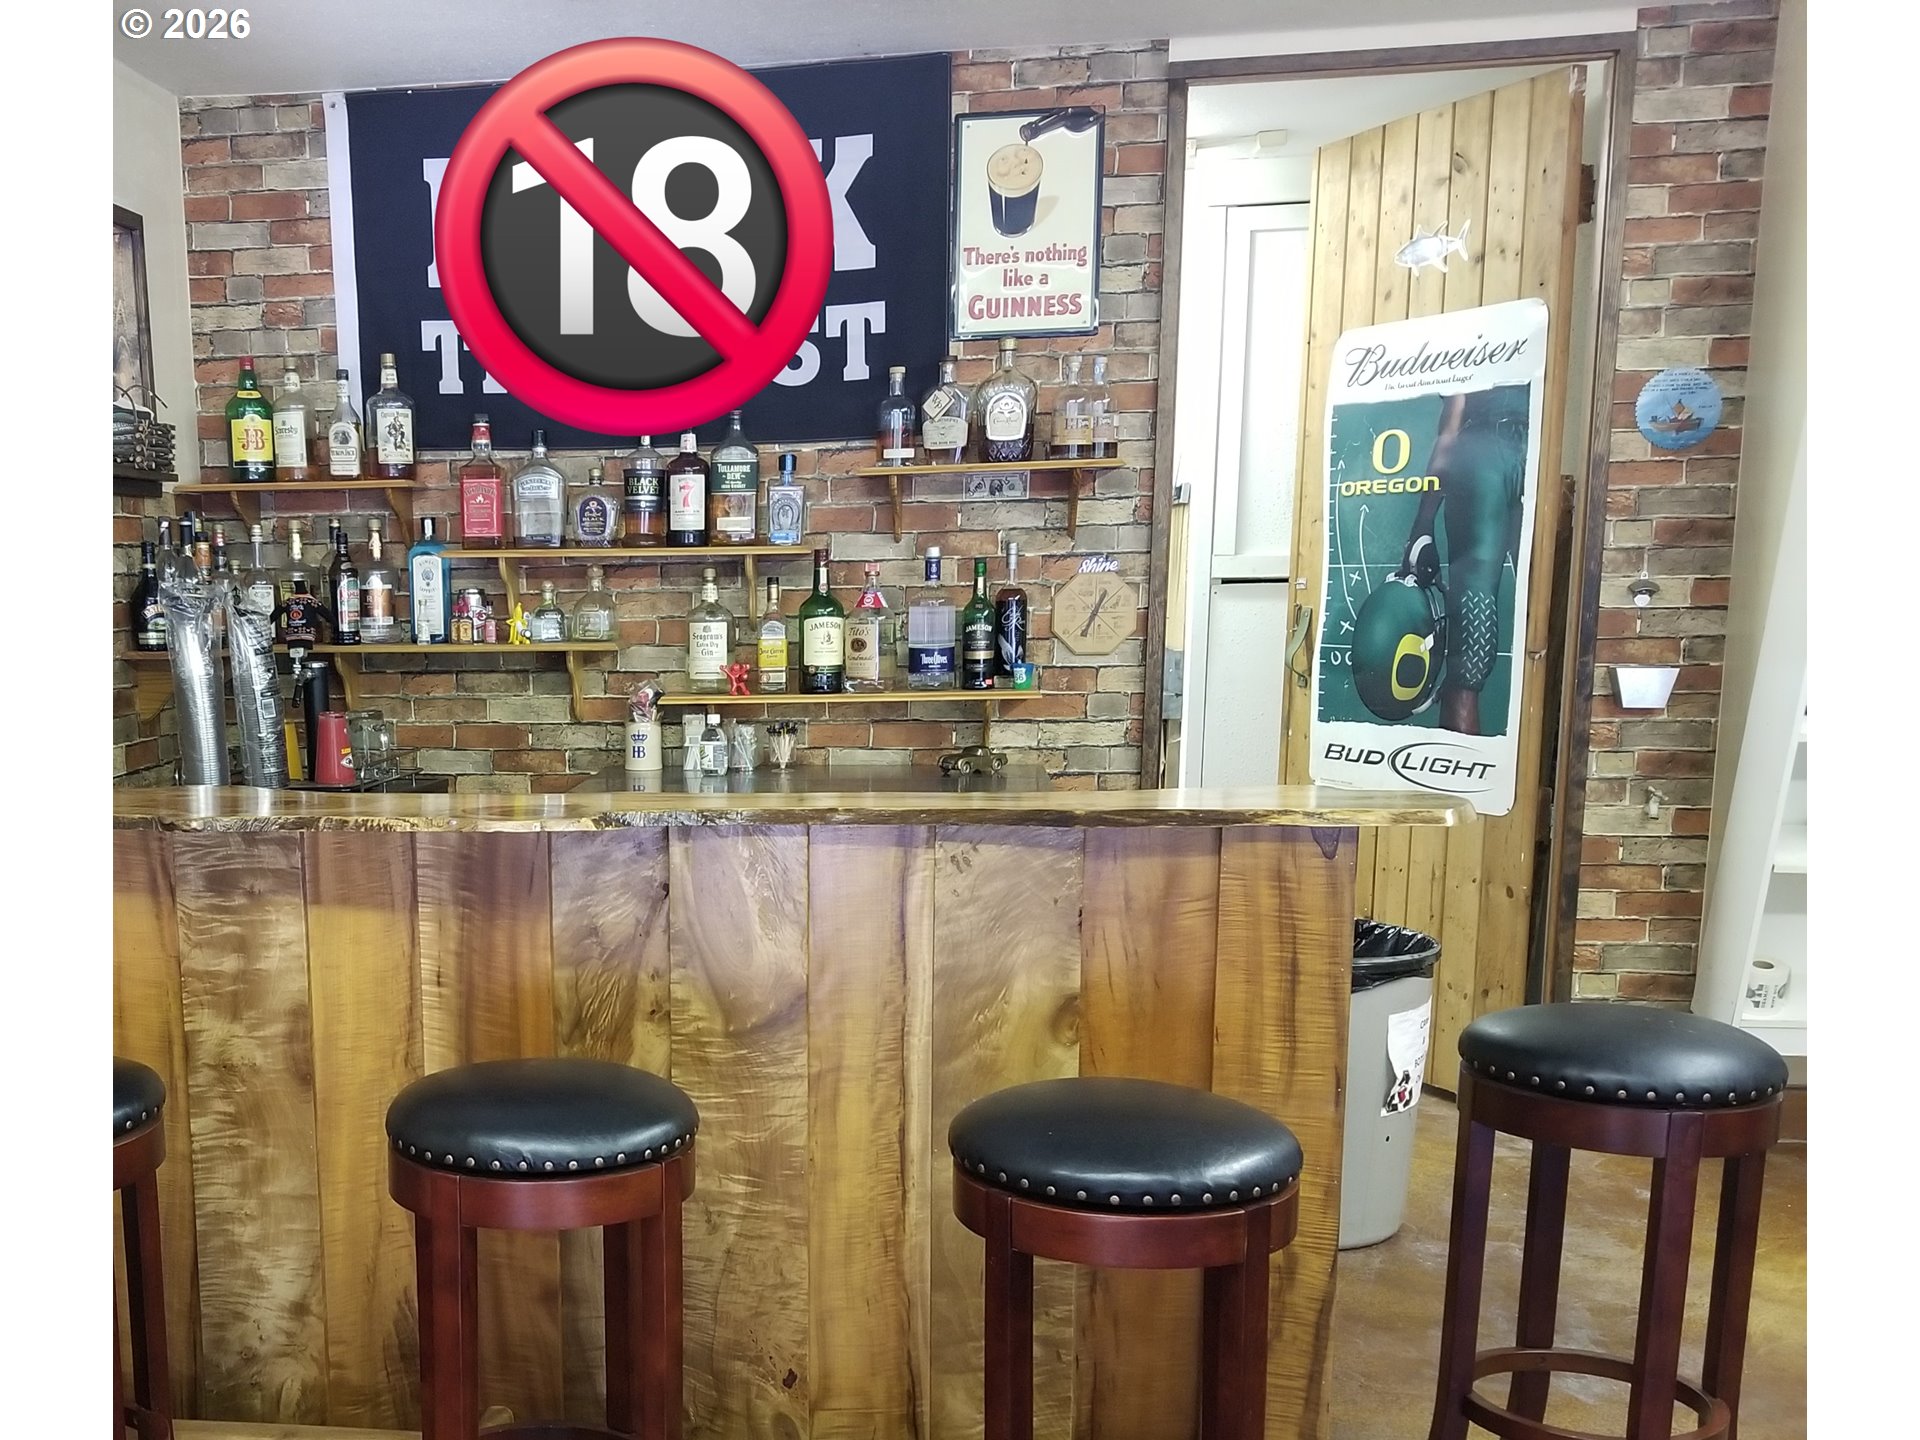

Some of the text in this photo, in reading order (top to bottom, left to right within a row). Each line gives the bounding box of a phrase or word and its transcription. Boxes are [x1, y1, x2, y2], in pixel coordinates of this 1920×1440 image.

[963, 243, 1088, 267] There's nothing
[1003, 268, 1049, 287] like a
[968, 293, 1082, 320] GUINNESS
[1345, 333, 1528, 388] Budweiser
[717, 463, 751, 472] TULLAMORE
[628, 477, 659, 486] BLACK
[1341, 476, 1440, 496] OREGON
[627, 486, 660, 495] VELVET
[679, 482, 695, 507] 7
[1079, 557, 1118, 574] Shine
[810, 621, 841, 631] JAMESON
[848, 627, 870, 636] Tito's
[965, 624, 992, 632] JAMESON
[692, 632, 723, 641] Seagram's
[701, 648, 713, 656] Gin
[1324, 743, 1496, 780] BUD LIGHT
